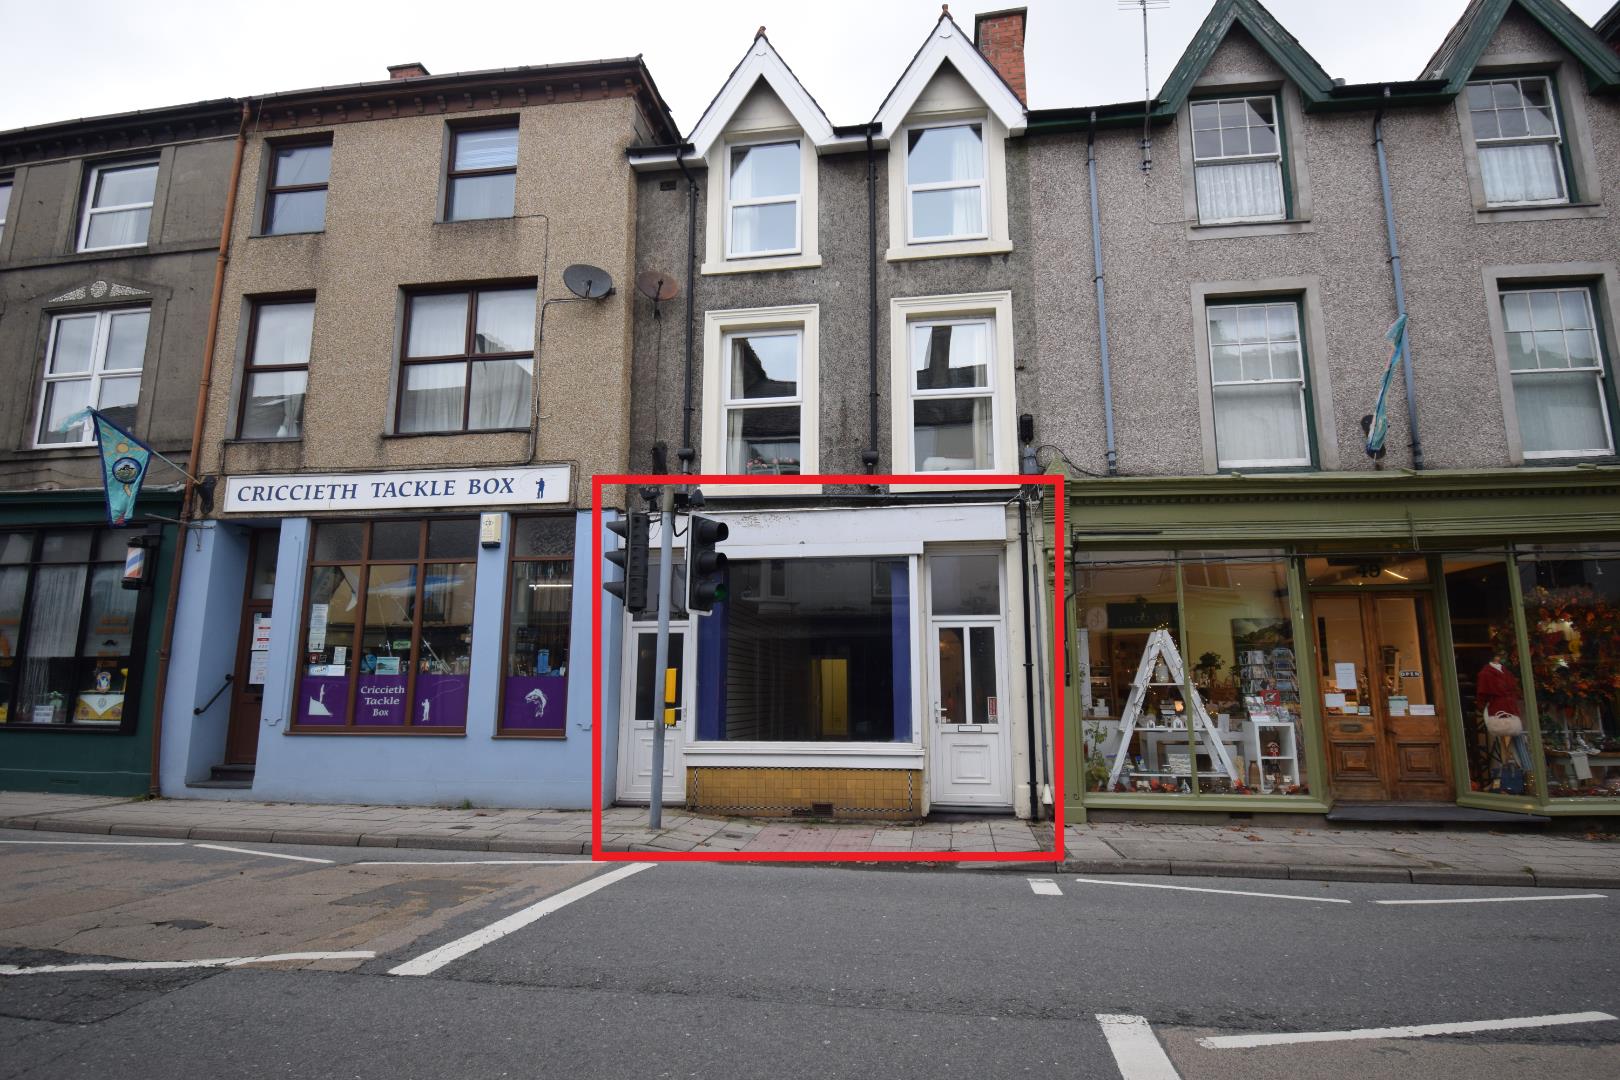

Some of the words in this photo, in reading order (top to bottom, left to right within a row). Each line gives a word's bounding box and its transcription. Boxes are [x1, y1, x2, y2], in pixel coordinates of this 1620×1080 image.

[237, 483, 358, 502] CRICCIETH
[371, 479, 456, 498] TACKLE
[467, 477, 515, 495] BOX
[360, 685, 405, 694] Criccieth
[364, 696, 400, 705] Tackle
[372, 708, 389, 717] Box
